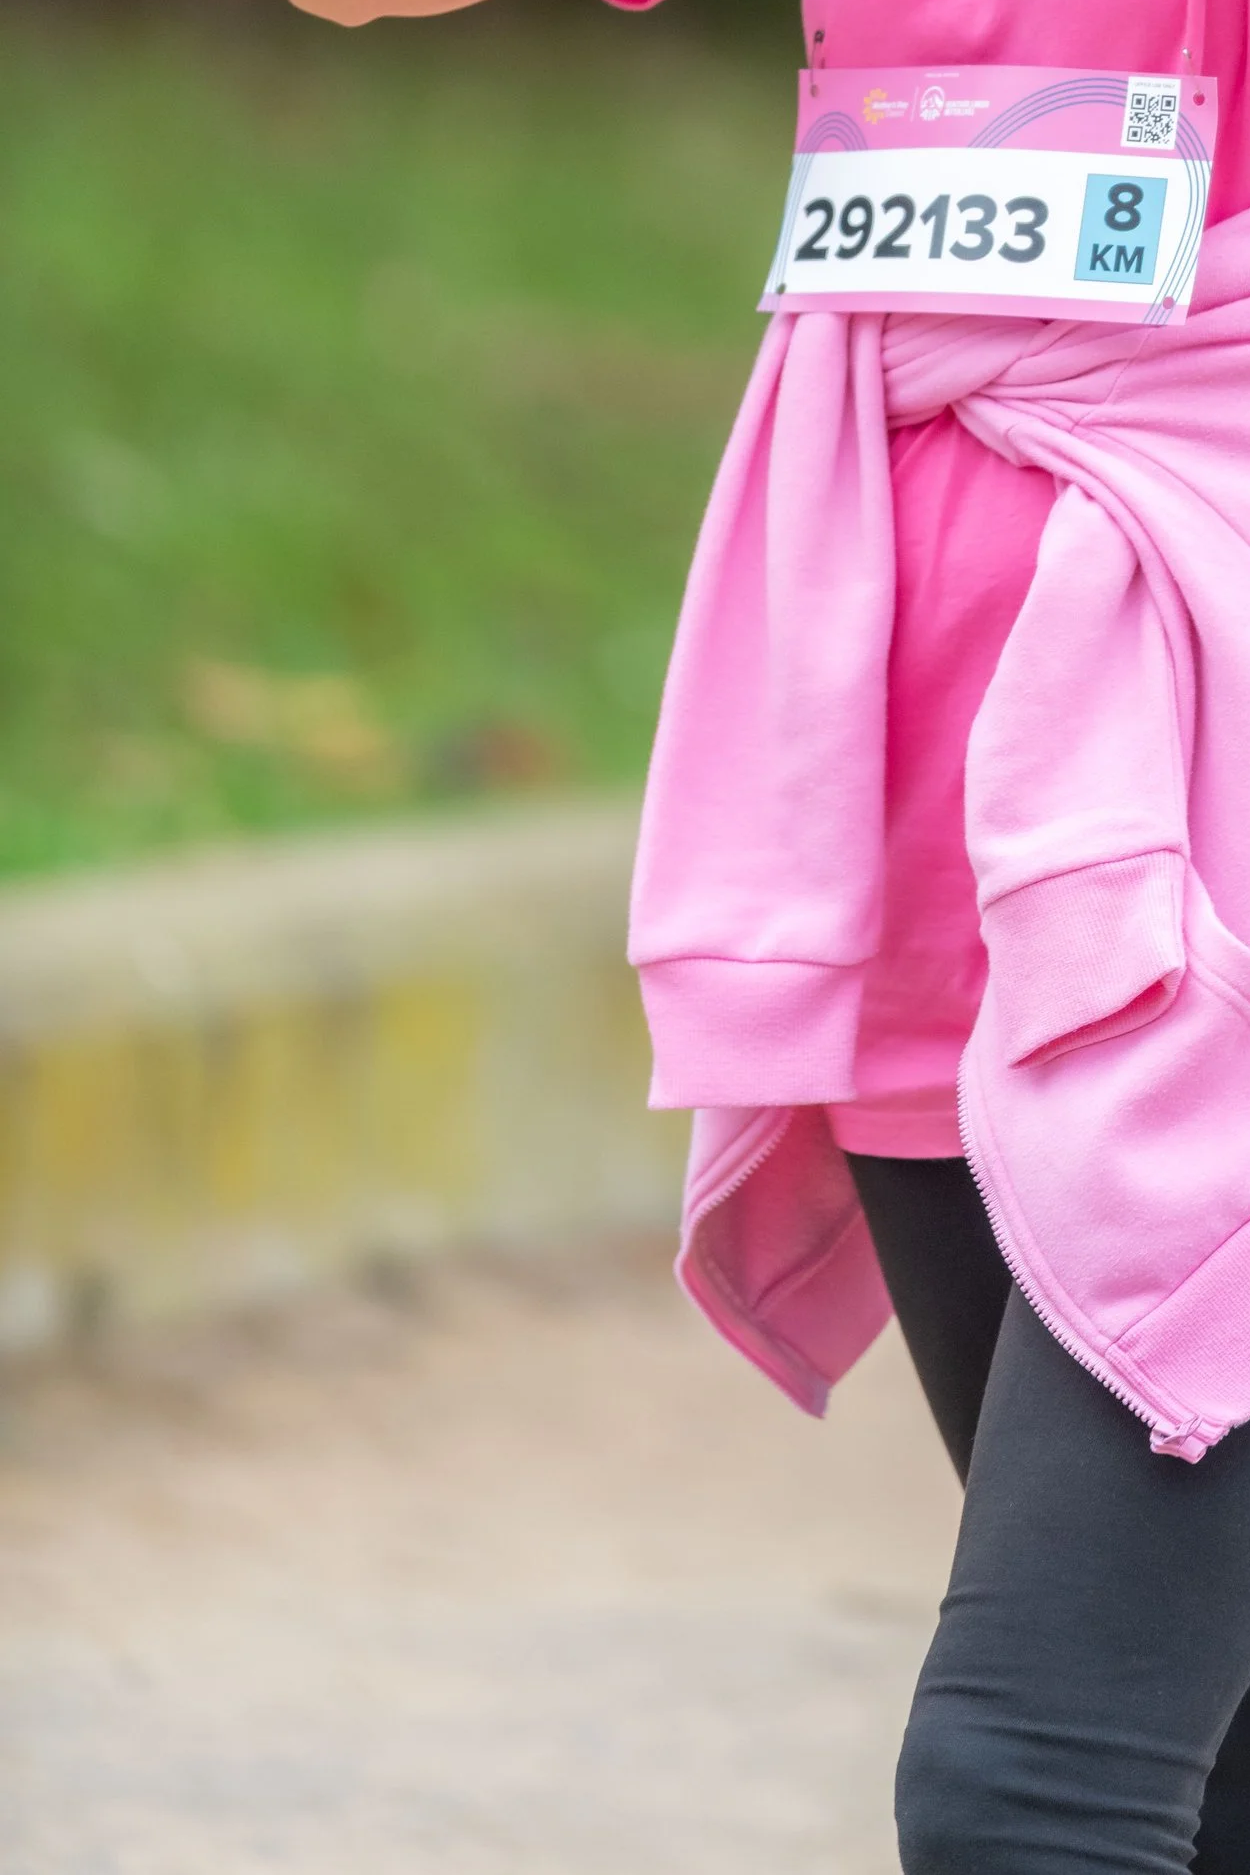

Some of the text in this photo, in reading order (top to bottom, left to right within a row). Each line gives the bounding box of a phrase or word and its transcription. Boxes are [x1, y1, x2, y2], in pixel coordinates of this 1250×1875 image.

[794, 192, 1049, 263] 292133
[1104, 182, 1144, 232] 8
[1089, 243, 1145, 274] KM
